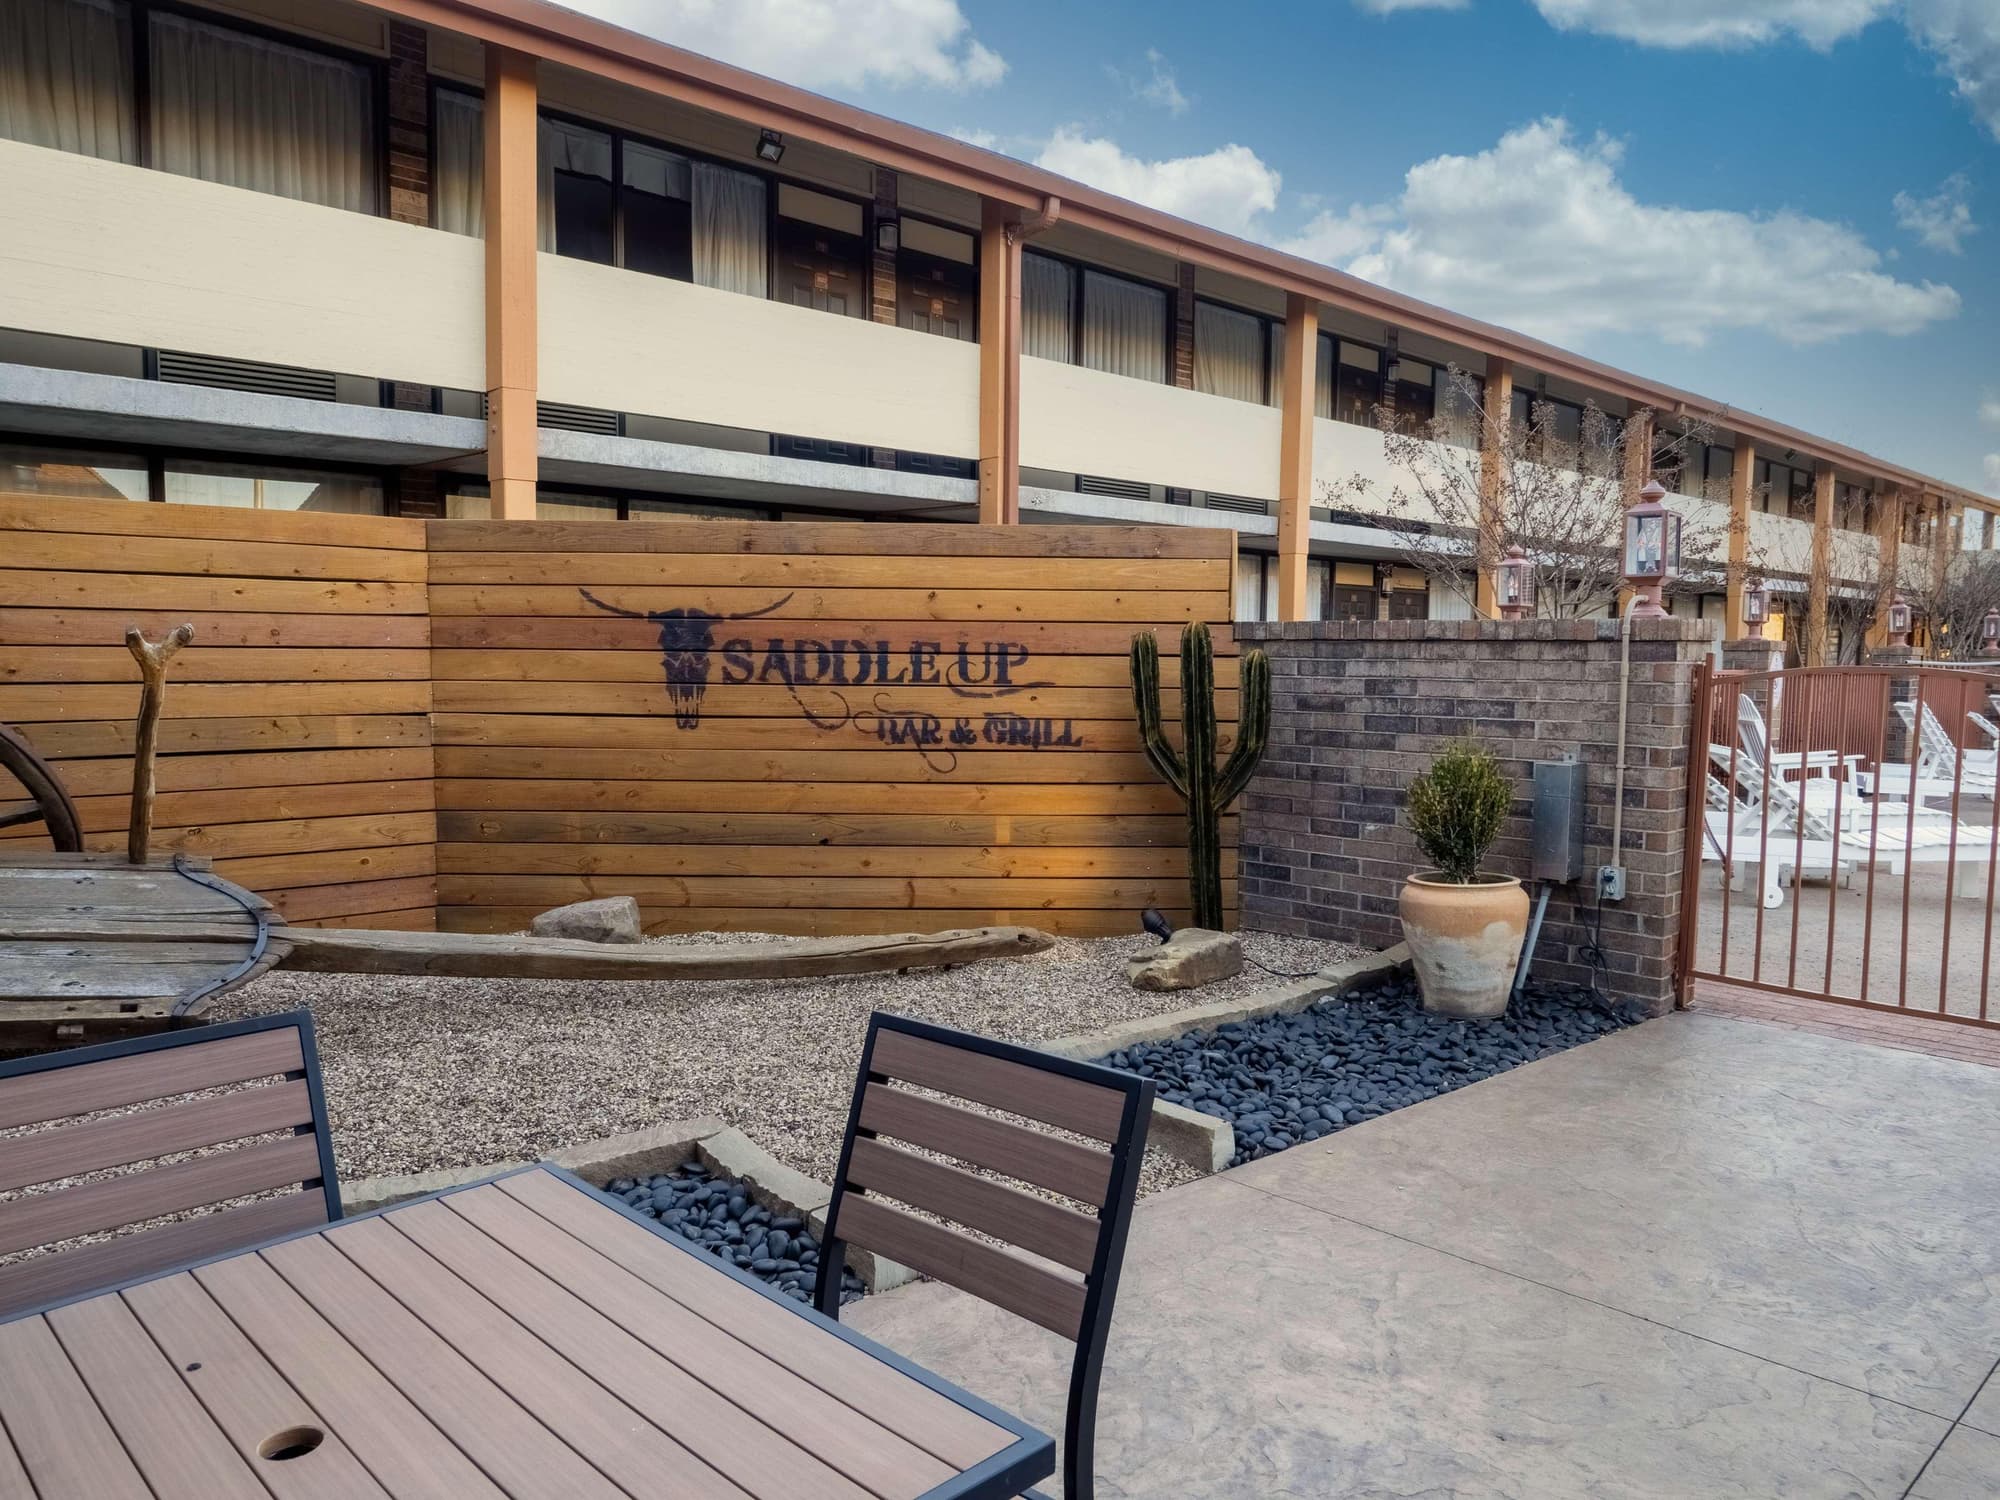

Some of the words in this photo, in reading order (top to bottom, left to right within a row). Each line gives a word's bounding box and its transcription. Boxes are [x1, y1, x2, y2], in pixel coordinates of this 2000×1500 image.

[721, 638, 941, 689] SADDLE
[951, 641, 1034, 690] UP
[875, 712, 943, 746] BAR
[949, 717, 977, 745] &
[982, 712, 1083, 748] GRILL
